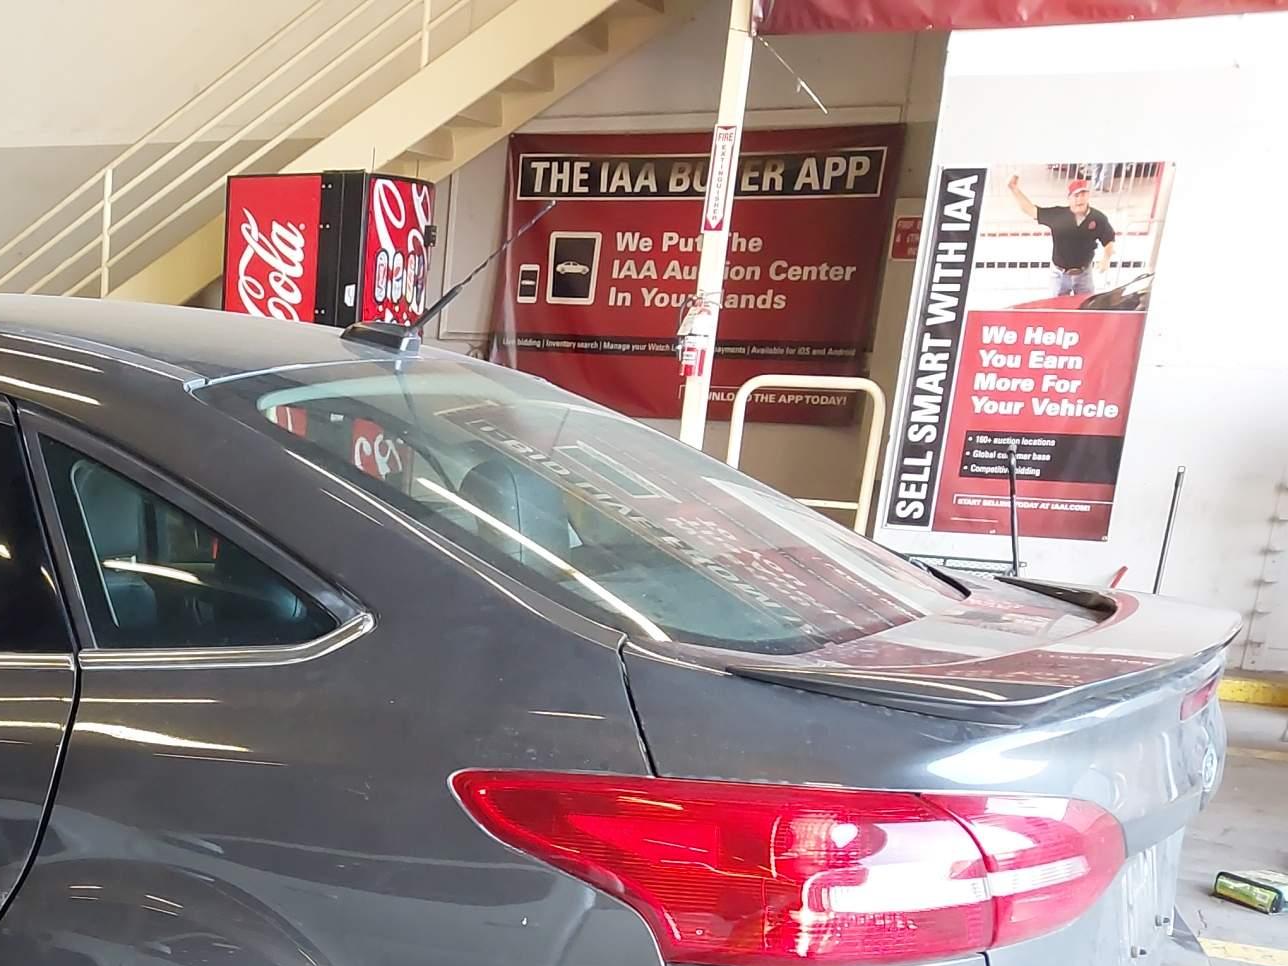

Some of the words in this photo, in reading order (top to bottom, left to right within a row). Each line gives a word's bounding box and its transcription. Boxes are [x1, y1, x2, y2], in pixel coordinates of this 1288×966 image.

[718, 132, 733, 142] FIRE
[530, 161, 590, 193] THE
[599, 161, 658, 193] IAA
[668, 157, 785, 194] BUER
[793, 155, 870, 192] APP
[711, 144, 726, 221] EXTINGUISHER
[942, 174, 979, 232] IAA
[616, 231, 653, 252] We
[728, 231, 763, 252] he
[612, 259, 658, 279] IAA
[662, 260, 761, 281] Auion
[768, 259, 857, 281] Center
[925, 241, 968, 327] WITH
[608, 287, 632, 306] In
[721, 289, 787, 309] ands
[517, 338, 541, 348] bidding
[546, 339, 576, 350] Inventory
[603, 342, 630, 351] Manage
[648, 343, 670, 351] Watch
[981, 326, 1018, 344] We
[1023, 327, 1079, 349] Help
[979, 350, 1021, 368] You
[1028, 351, 1082, 369] Earn
[907, 332, 952, 445] SMART
[973, 373, 1034, 392] More
[1041, 375, 1082, 393] For
[753, 393, 776, 403] THE
[777, 394, 802, 404] APP
[804, 395, 847, 405] TODAY!
[971, 396, 1025, 415] Your
[1031, 398, 1119, 418] Vehicle
[993, 437, 1021, 445] auction
[1021, 437, 1056, 447] locations
[972, 450, 996, 458] Global
[1032, 453, 1051, 461] base
[896, 449, 934, 520] SELL
